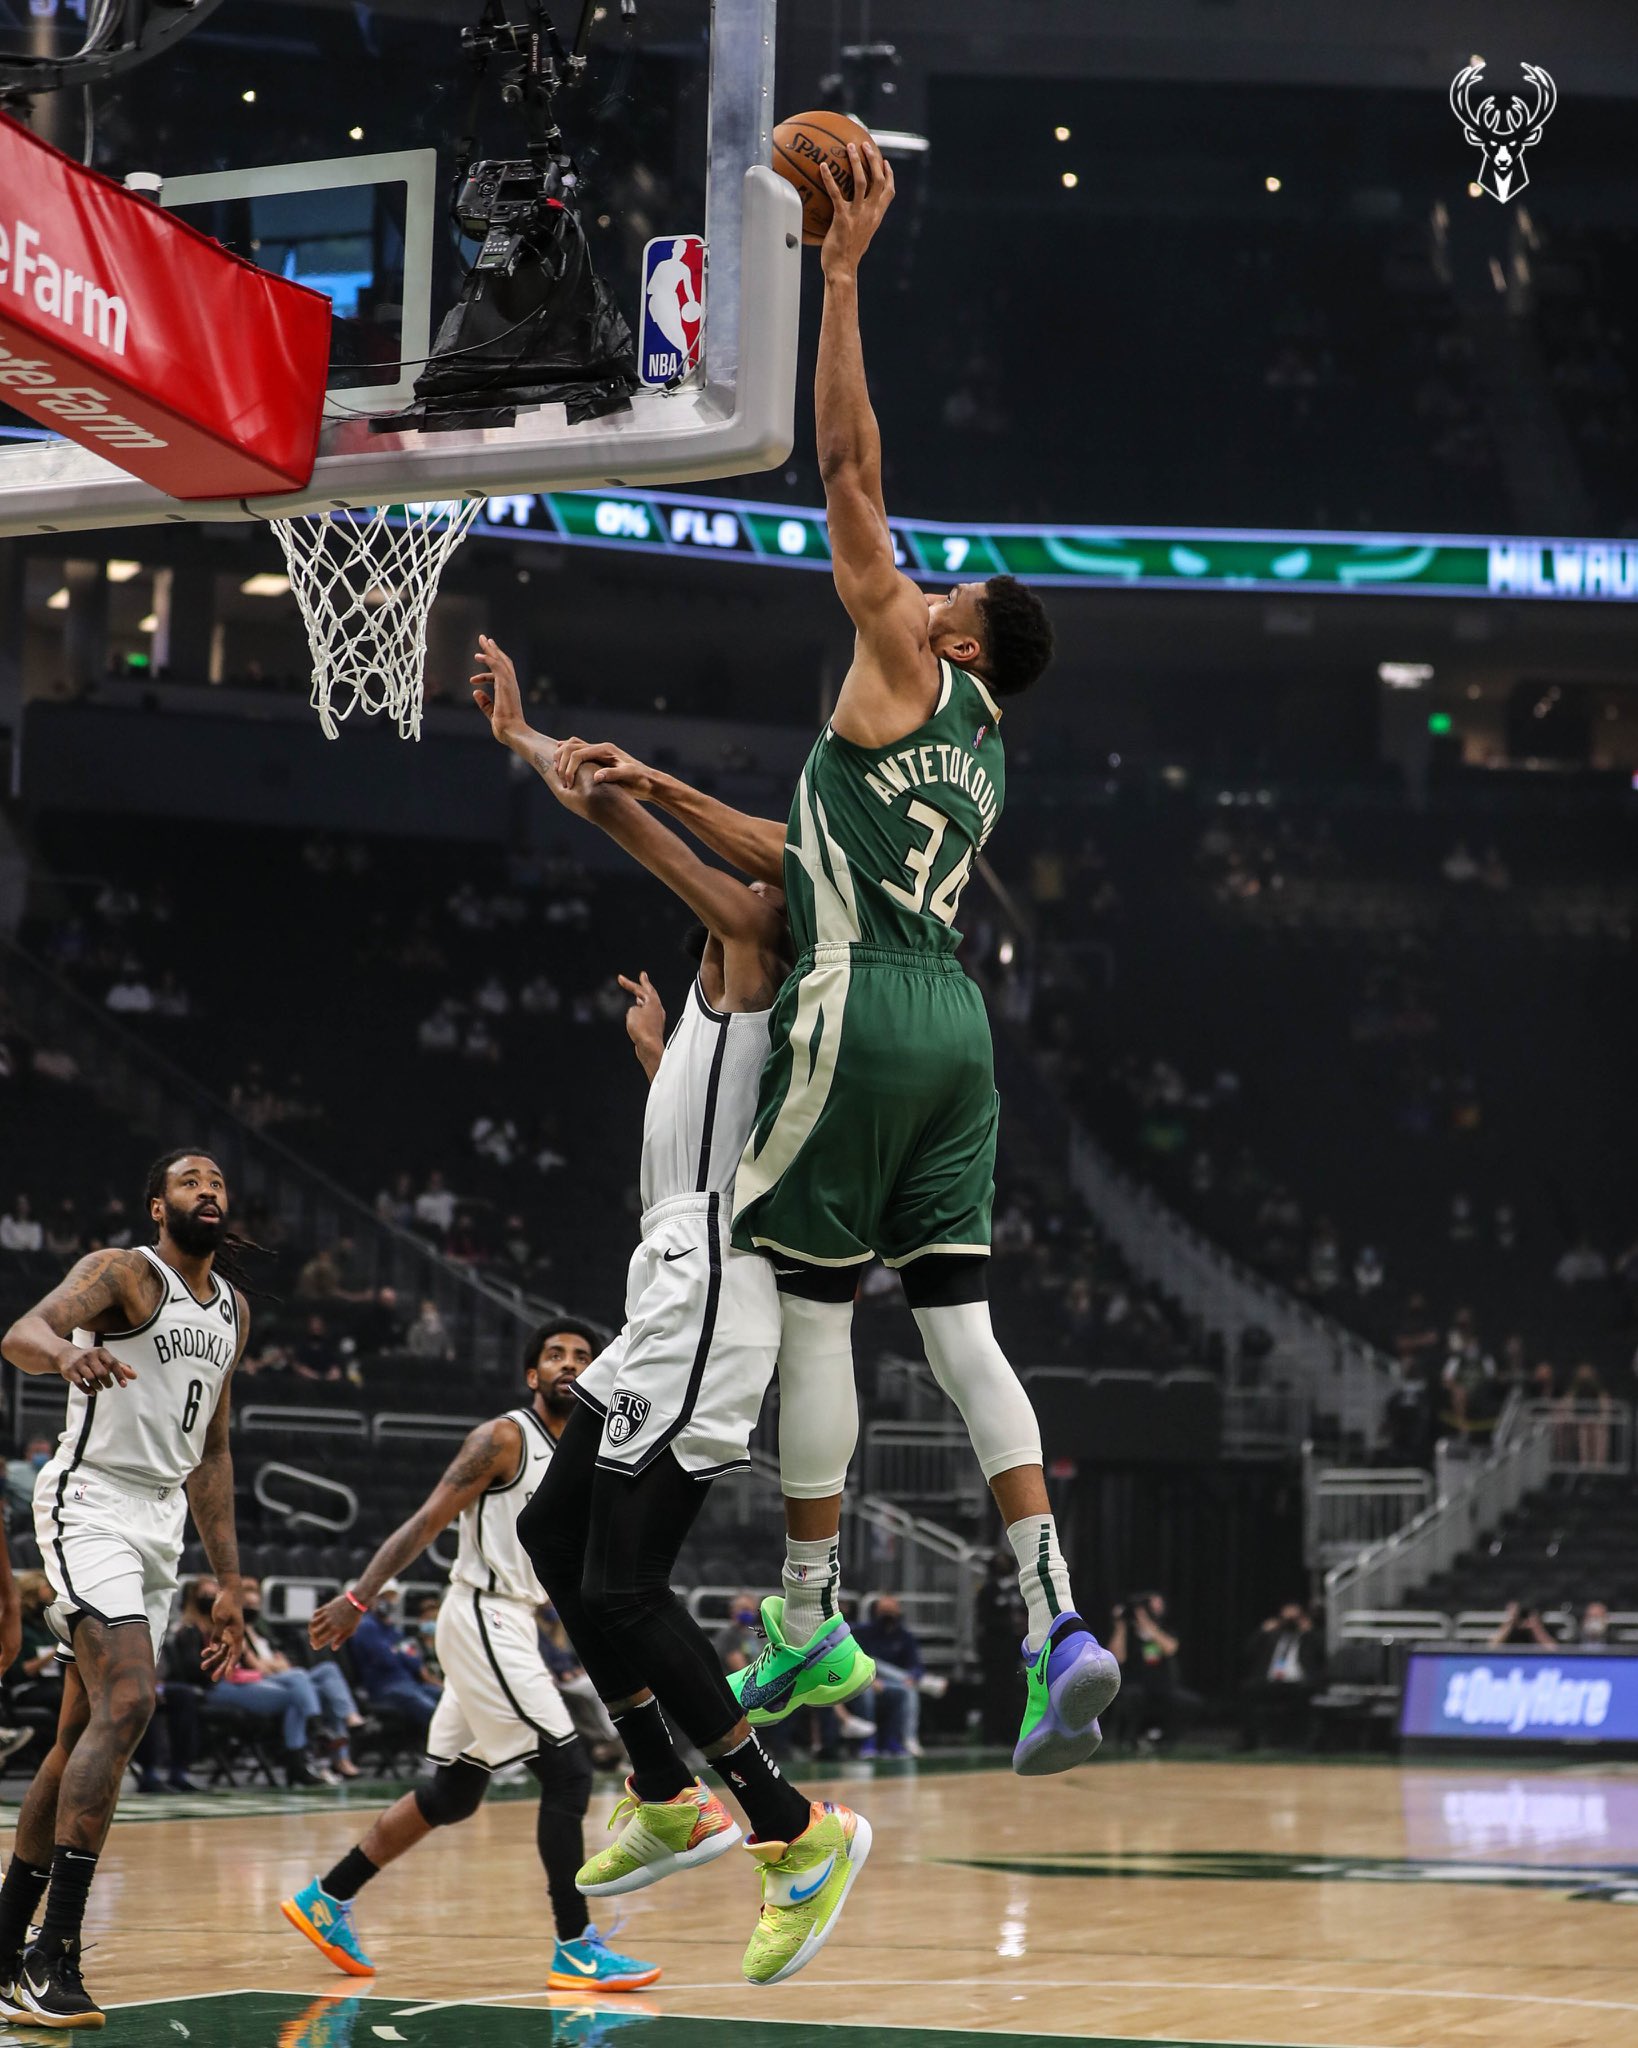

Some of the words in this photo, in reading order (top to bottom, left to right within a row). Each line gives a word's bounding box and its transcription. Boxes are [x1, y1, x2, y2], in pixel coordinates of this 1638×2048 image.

[785, 132, 854, 201] SPALDIN
[648, 353, 677, 377] NBA
[594, 500, 651, 539] 0%
[777, 519, 807, 555] 0
[942, 537, 971, 572] 7
[880, 799, 974, 928] 34
[181, 1378, 203, 1434] 6
[611, 1393, 645, 1421] NETS
[613, 1417, 624, 1438] B
